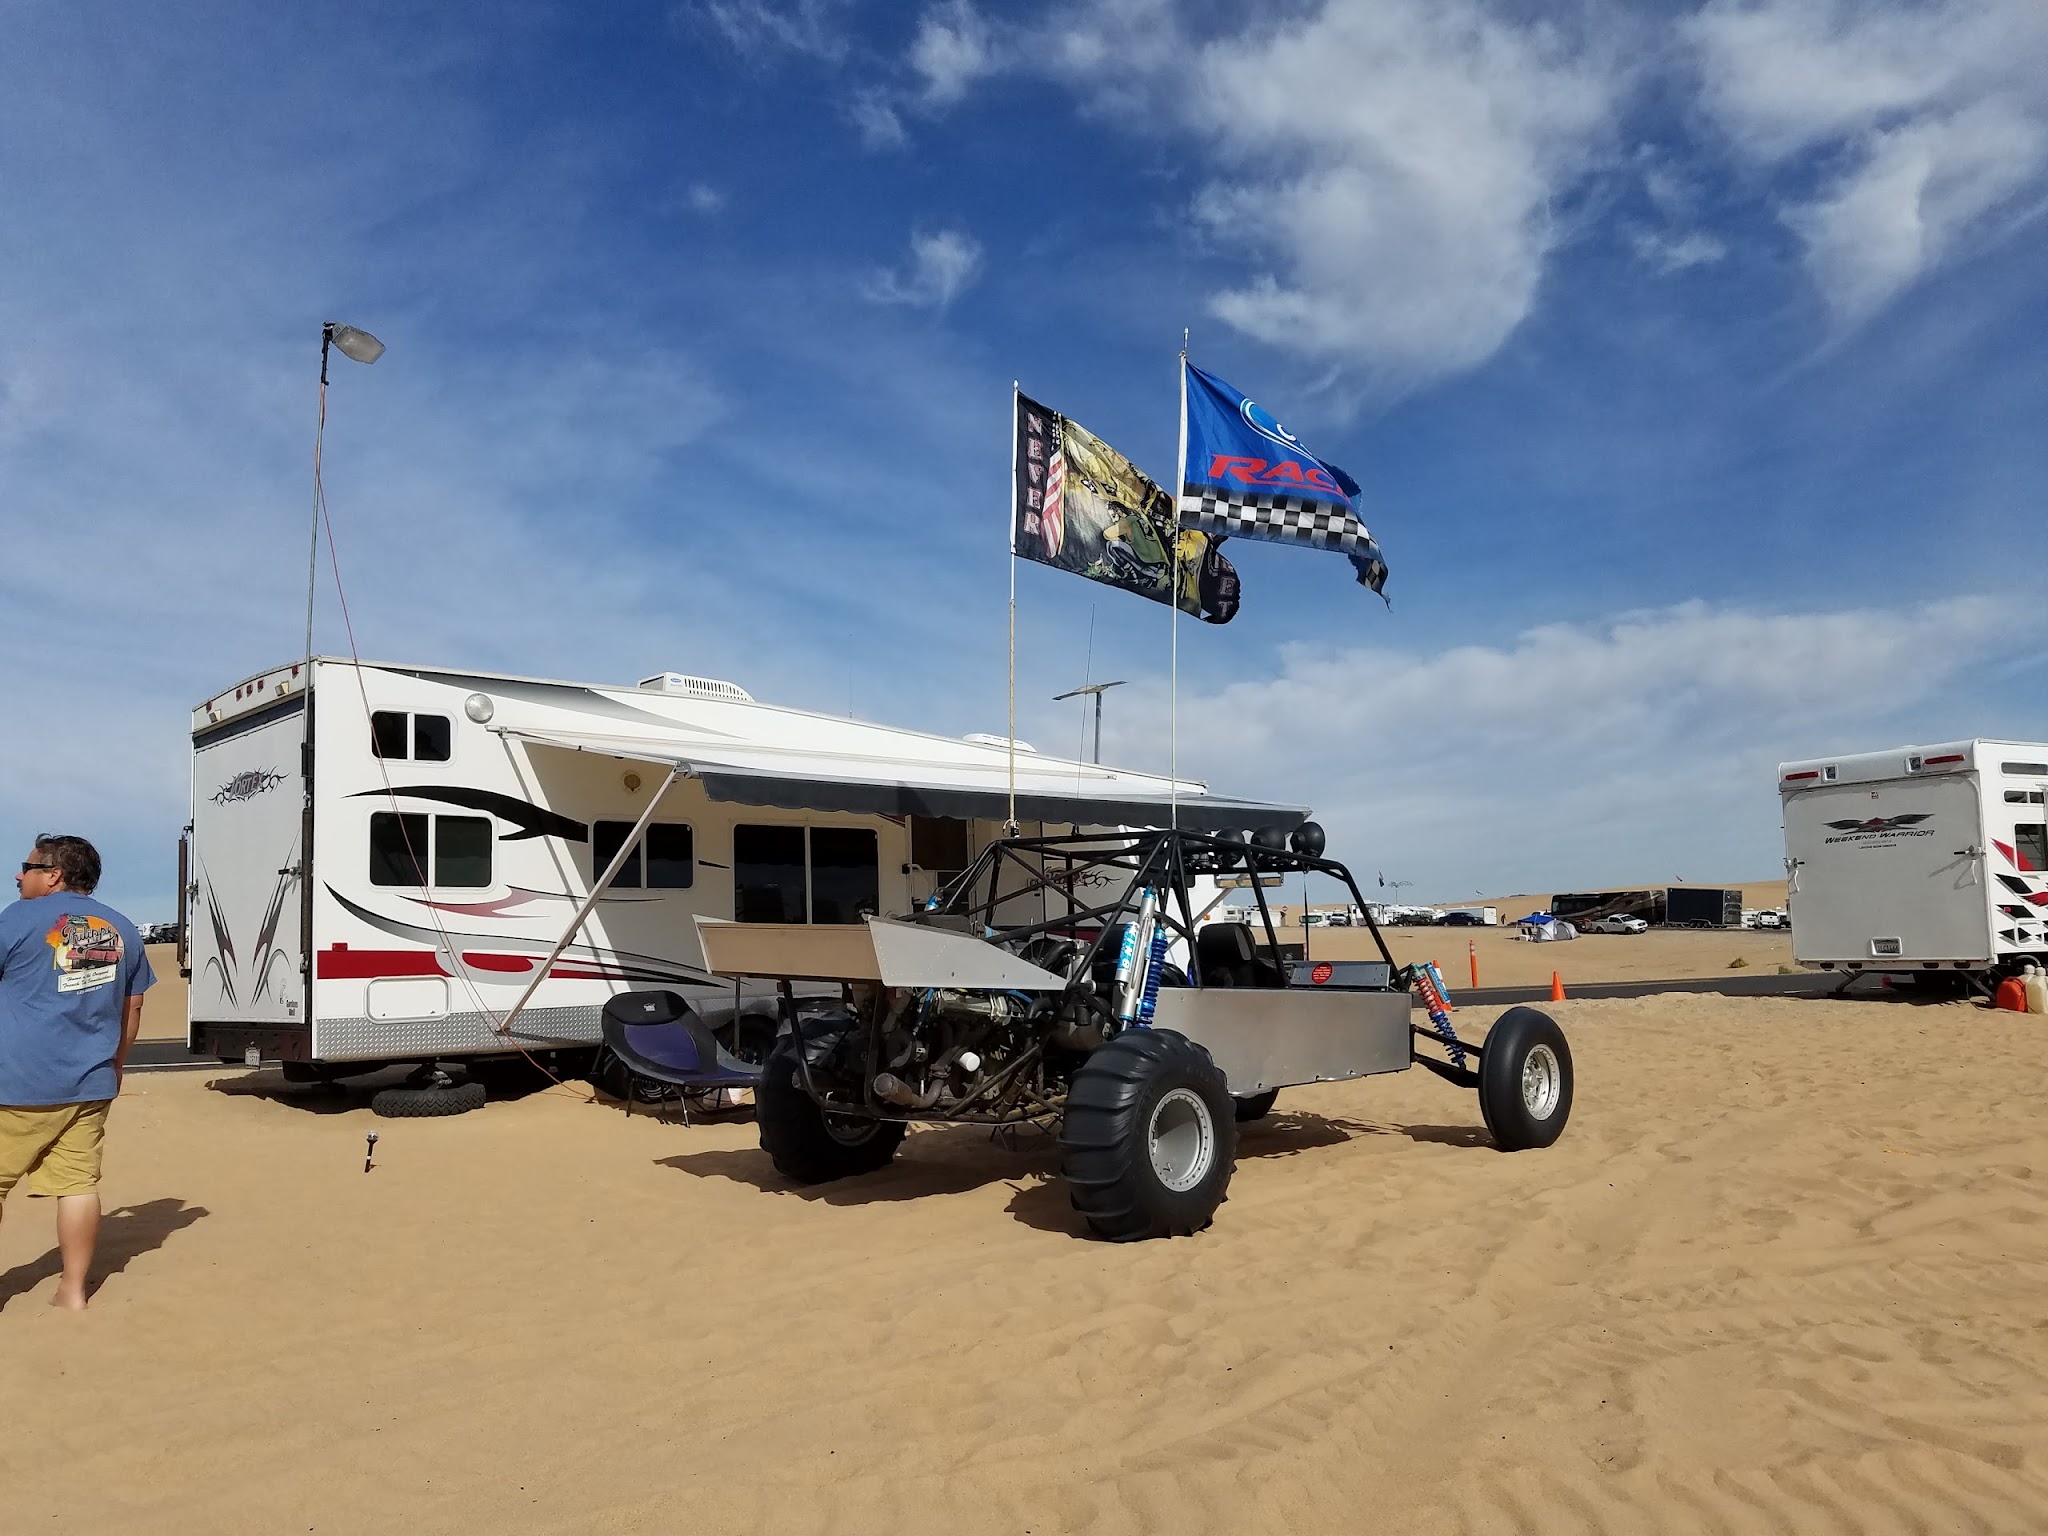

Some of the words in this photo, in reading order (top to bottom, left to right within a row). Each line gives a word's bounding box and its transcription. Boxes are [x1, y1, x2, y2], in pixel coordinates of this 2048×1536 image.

[1024, 412, 1042, 535] NEVER
[1208, 454, 1346, 496] RAC
[228, 773, 263, 800] VORTEX
[1825, 834, 1877, 845] WEEKEND
[1879, 830, 1935, 838] WARRIOR
